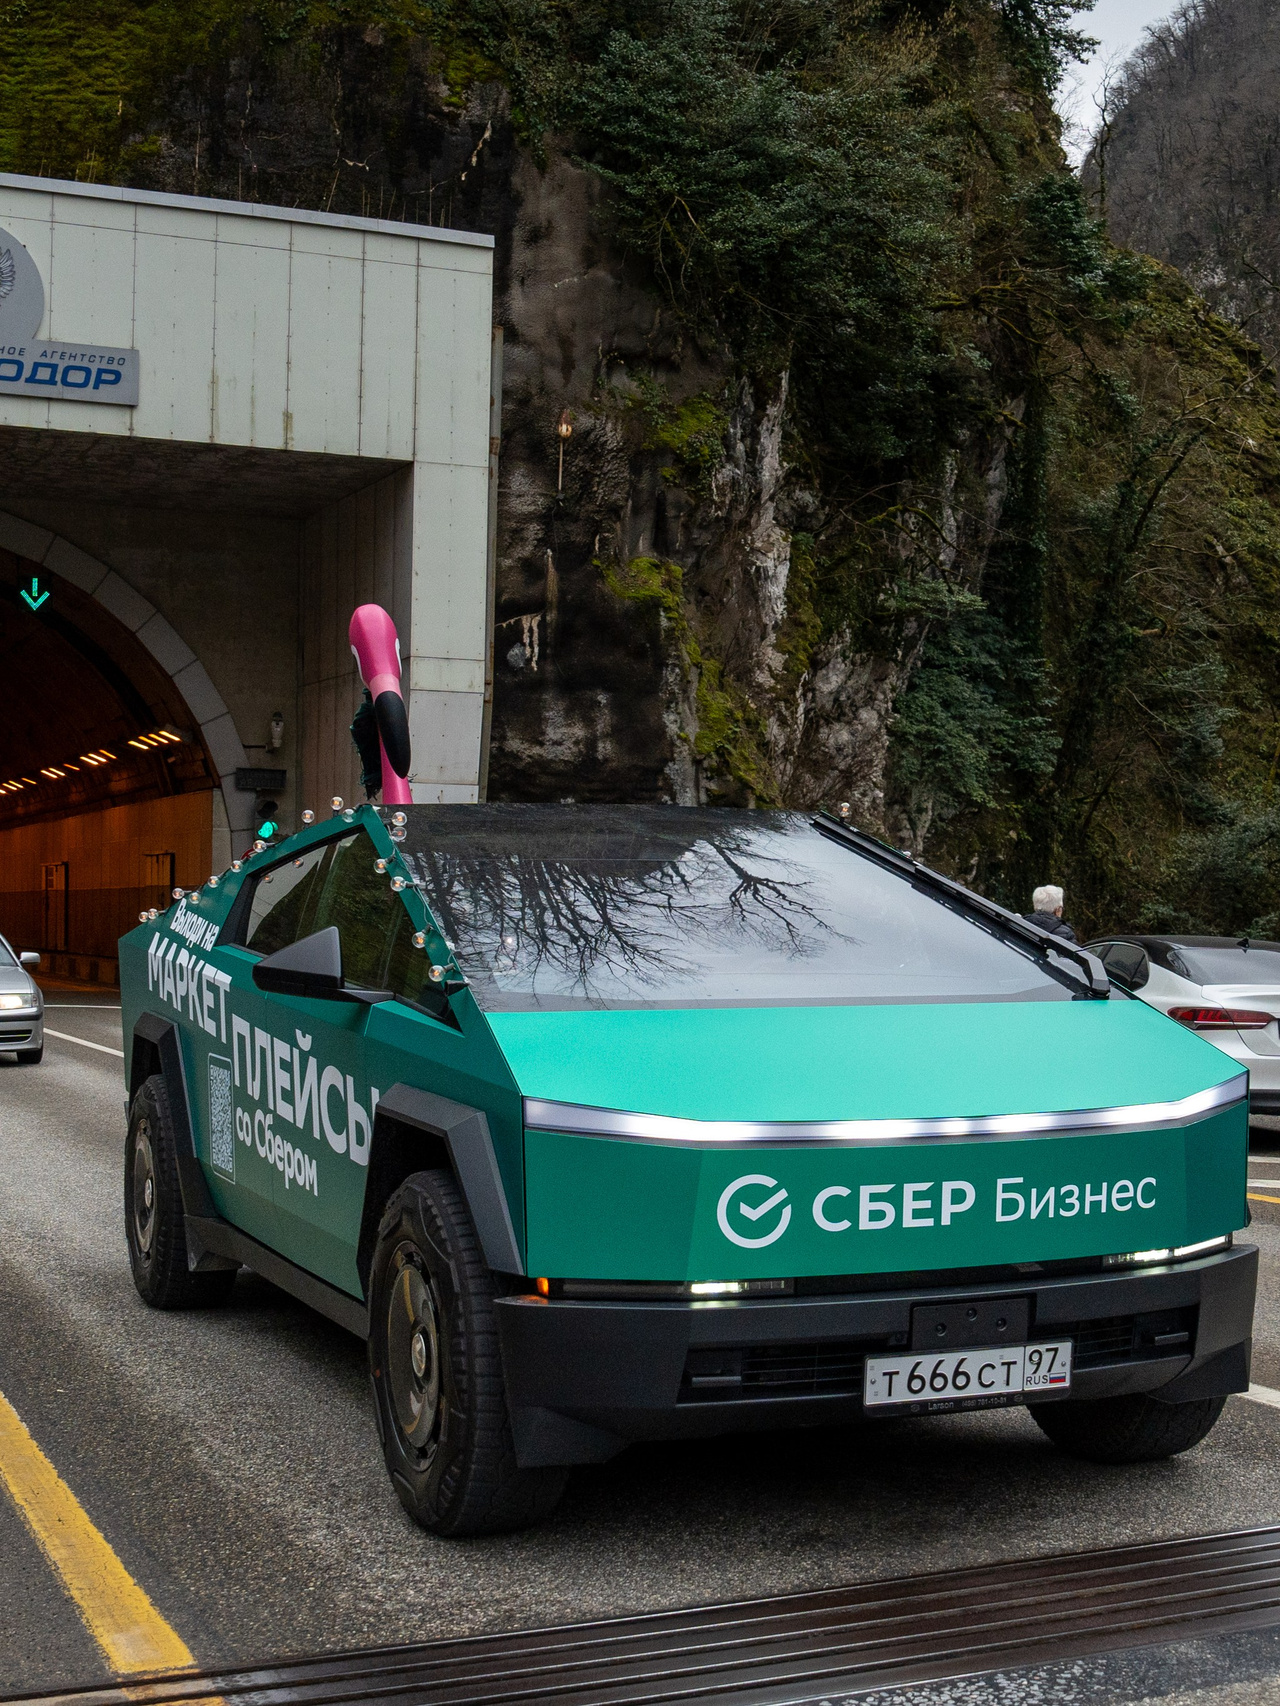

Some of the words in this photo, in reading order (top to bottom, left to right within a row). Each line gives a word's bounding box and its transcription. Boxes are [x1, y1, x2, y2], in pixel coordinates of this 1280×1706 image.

[0, 358, 122, 390] ОДОР
[40, 350, 126, 366] АГЕНТСТВО
[170, 898, 209, 949] Выходи
[201, 922, 220, 952] на
[148, 931, 232, 1044] МАРКЕТ
[232, 1013, 380, 1166] ПЛЕЙСЫ
[236, 1107, 252, 1146] со
[254, 1109, 318, 1197] Сбером
[812, 1180, 976, 1232] СБЕР
[995, 1176, 1157, 1223] Бизнес
[882, 1356, 1018, 1397] Т666СТ
[1028, 1347, 1060, 1375] 97
[1025, 1373, 1049, 1386] RUS
[928, 1402, 955, 1411] Larson
